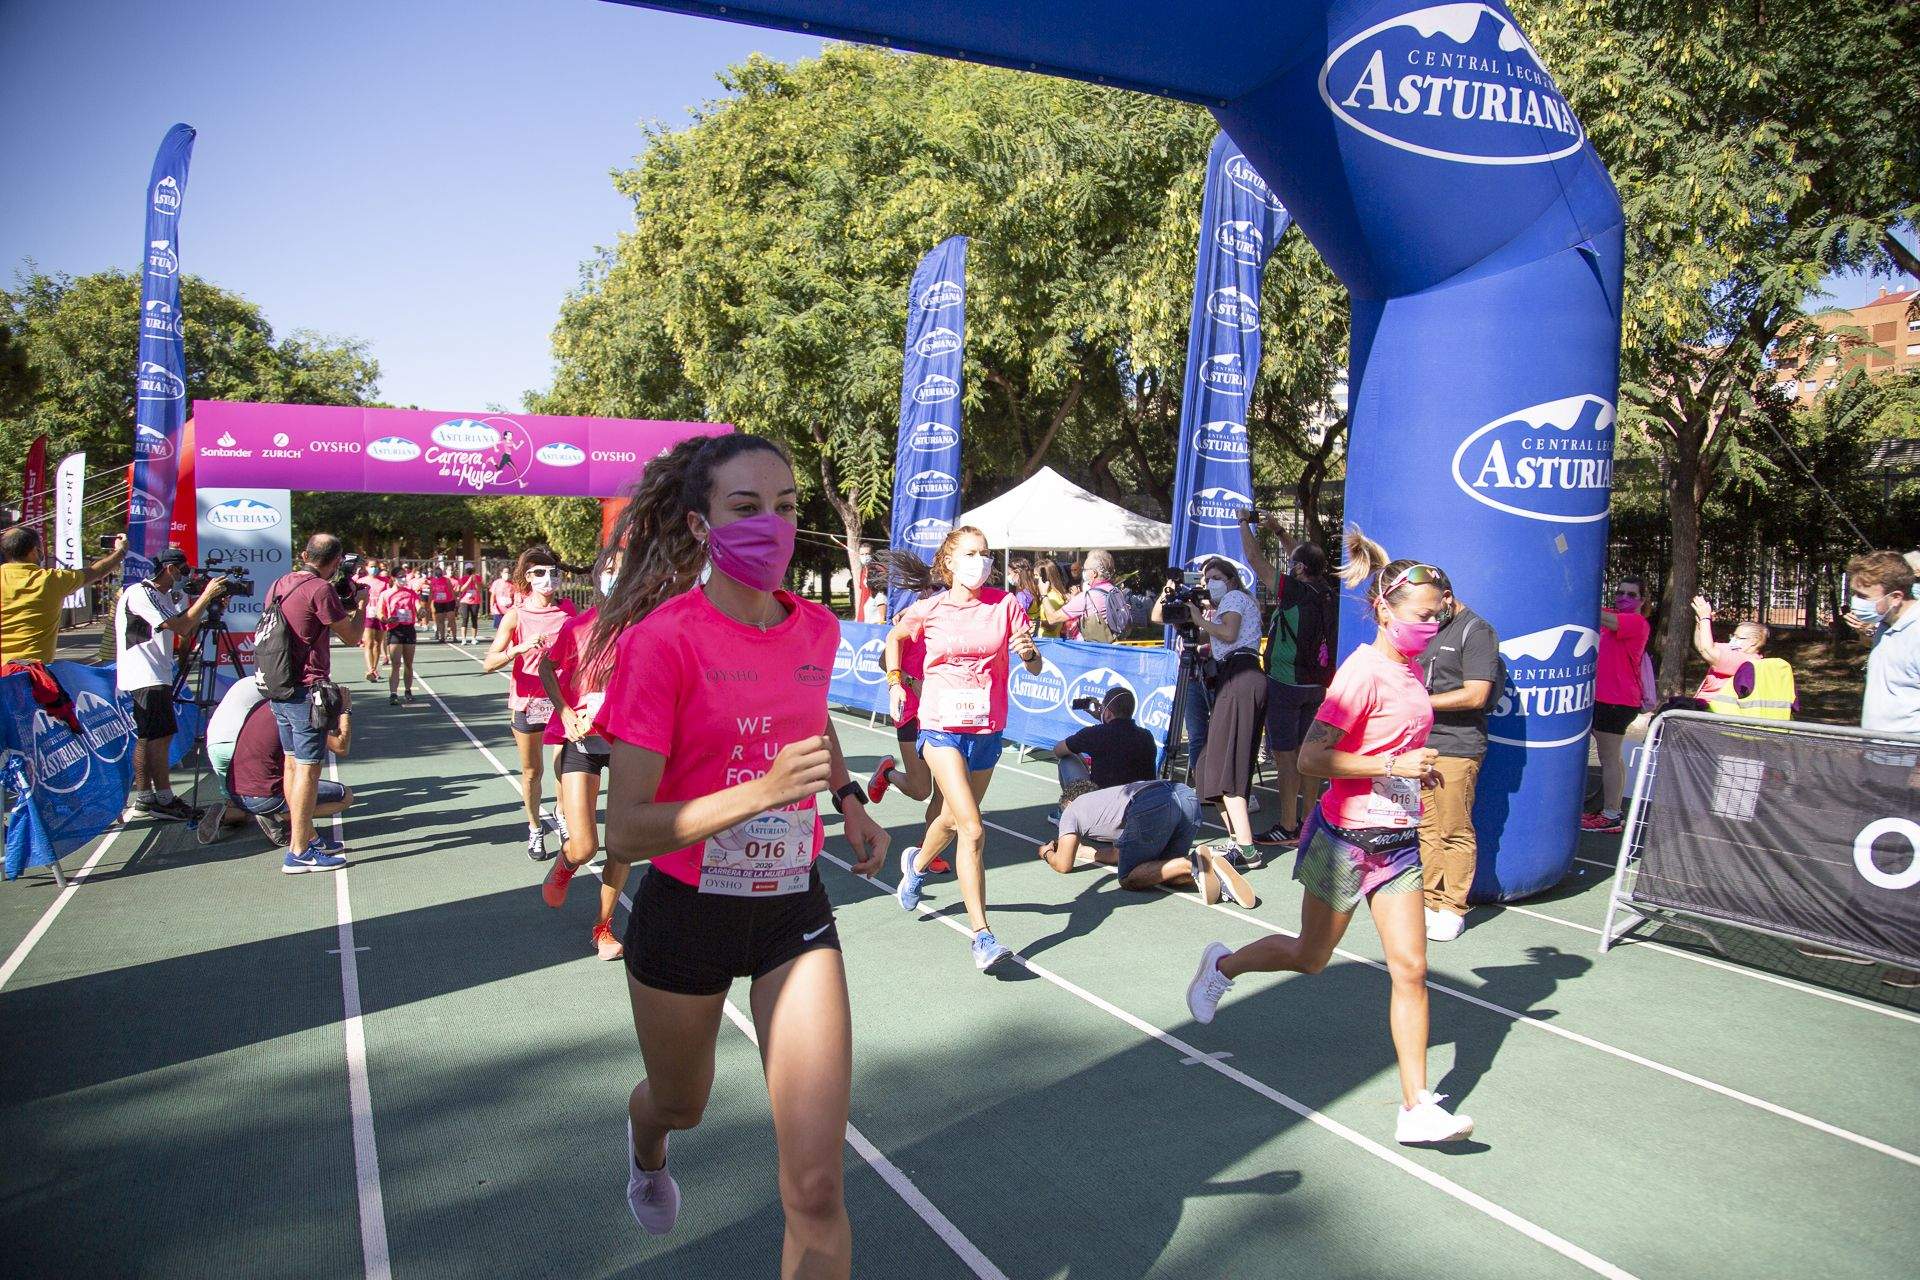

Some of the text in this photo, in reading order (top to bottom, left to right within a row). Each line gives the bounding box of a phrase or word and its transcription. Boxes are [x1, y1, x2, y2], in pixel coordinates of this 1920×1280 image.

[1408, 49, 1499, 74] CENTRAL
[1341, 49, 1577, 136] ASTURIANA
[437, 430, 495, 442] ASTURIANA
[1521, 437, 1593, 450] CENTRAL
[201, 447, 252, 459] Santander
[262, 449, 301, 459] ZURICH
[310, 440, 361, 455] OYSHO
[425, 446, 484, 464] Carrera
[591, 450, 637, 463] OYSHO
[438, 463, 503, 490] de la Mujer
[910, 482, 954, 494] ASTURIANA
[212, 511, 277, 524] ASTURIANA
[208, 548, 282, 564] OYSHO
[227, 602, 264, 614] URIC
[706, 669, 758, 684] OYSHO
[1012, 674, 1061, 701] ASTURIANA
[1485, 679, 1596, 716] STURIA
[956, 702, 975, 711] 016
[737, 716, 773, 735] WE
[1391, 793, 1411, 805] 016
[745, 841, 786, 859] 016
[708, 867, 741, 877] CARRERA
[754, 870, 763, 878] LA
[764, 869, 786, 878] MUJER
[705, 878, 742, 890] OYSHO
